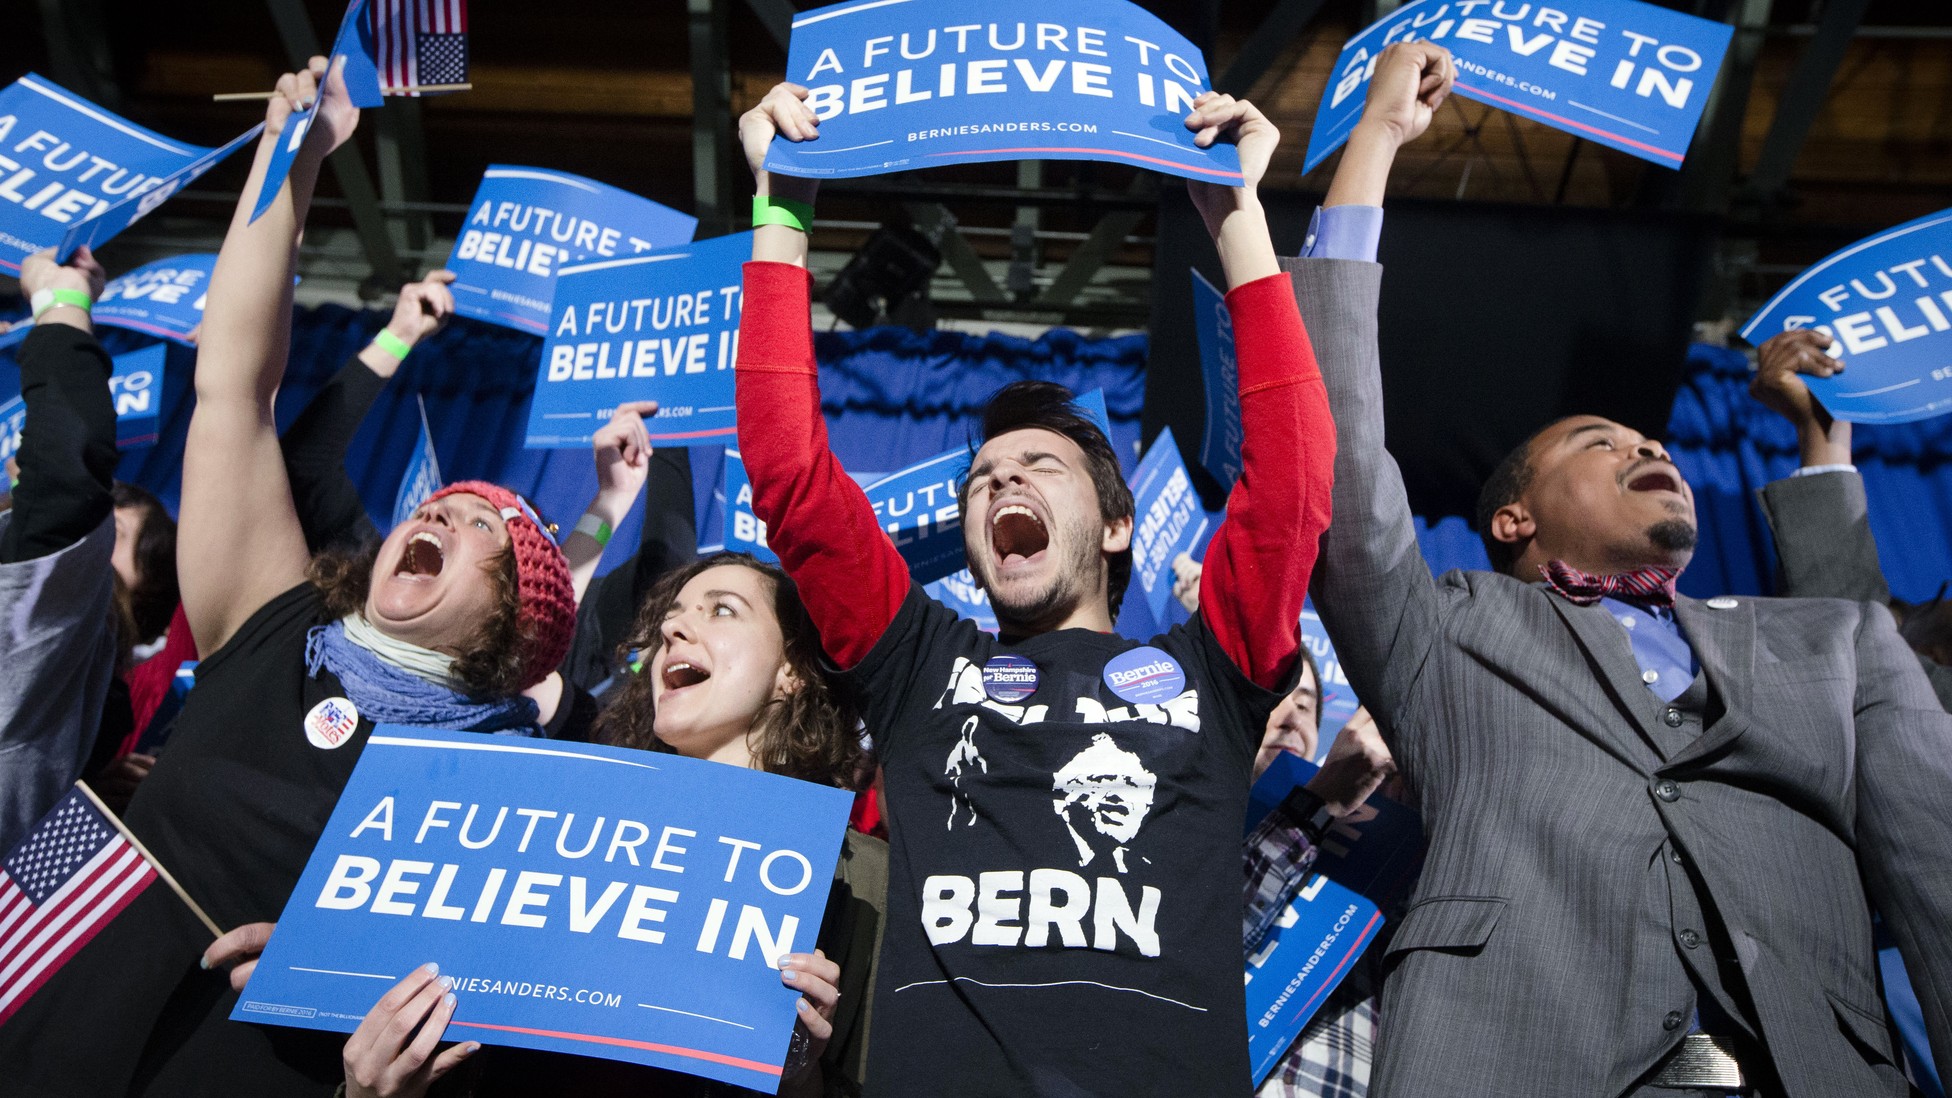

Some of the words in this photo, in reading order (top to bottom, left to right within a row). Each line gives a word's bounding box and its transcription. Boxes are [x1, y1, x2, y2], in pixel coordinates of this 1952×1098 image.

[806, 47, 845, 81] A
[862, 22, 1108, 69] FUTURE
[1123, 35, 1203, 86] TO
[1341, 46, 1369, 78] A
[1381, 0, 1606, 47] FUTURE
[1621, 30, 1703, 73] TO
[806, 58, 1114, 122] BELIEVE
[1138, 73, 1205, 115] IN
[1452, 55, 1557, 102] ANDERS.COM
[1609, 58, 1694, 110] IN
[907, 121, 1098, 142] BERNIESANDERS.COM
[456, 229, 569, 278] BELIE
[470, 199, 493, 227] A
[493, 201, 623, 258] FUTURE
[555, 304, 578, 338] A
[584, 290, 714, 336] FUTURE
[719, 284, 743, 321] T
[546, 332, 710, 383] BELIEVE
[993, 672, 1037, 682] Bernie
[1108, 660, 1175, 686] Bernie
[1140, 679, 1159, 689] 2016
[349, 795, 395, 842] A
[414, 800, 697, 874] FUTURE
[717, 835, 813, 897] TO
[314, 853, 681, 946] BELIEVE
[695, 897, 801, 971] IN
[920, 868, 1162, 958] BERN
[450, 976, 623, 1009] NIESANDERS.COM
[1257, 903, 1359, 1029] BERNIESANDERS.COM
